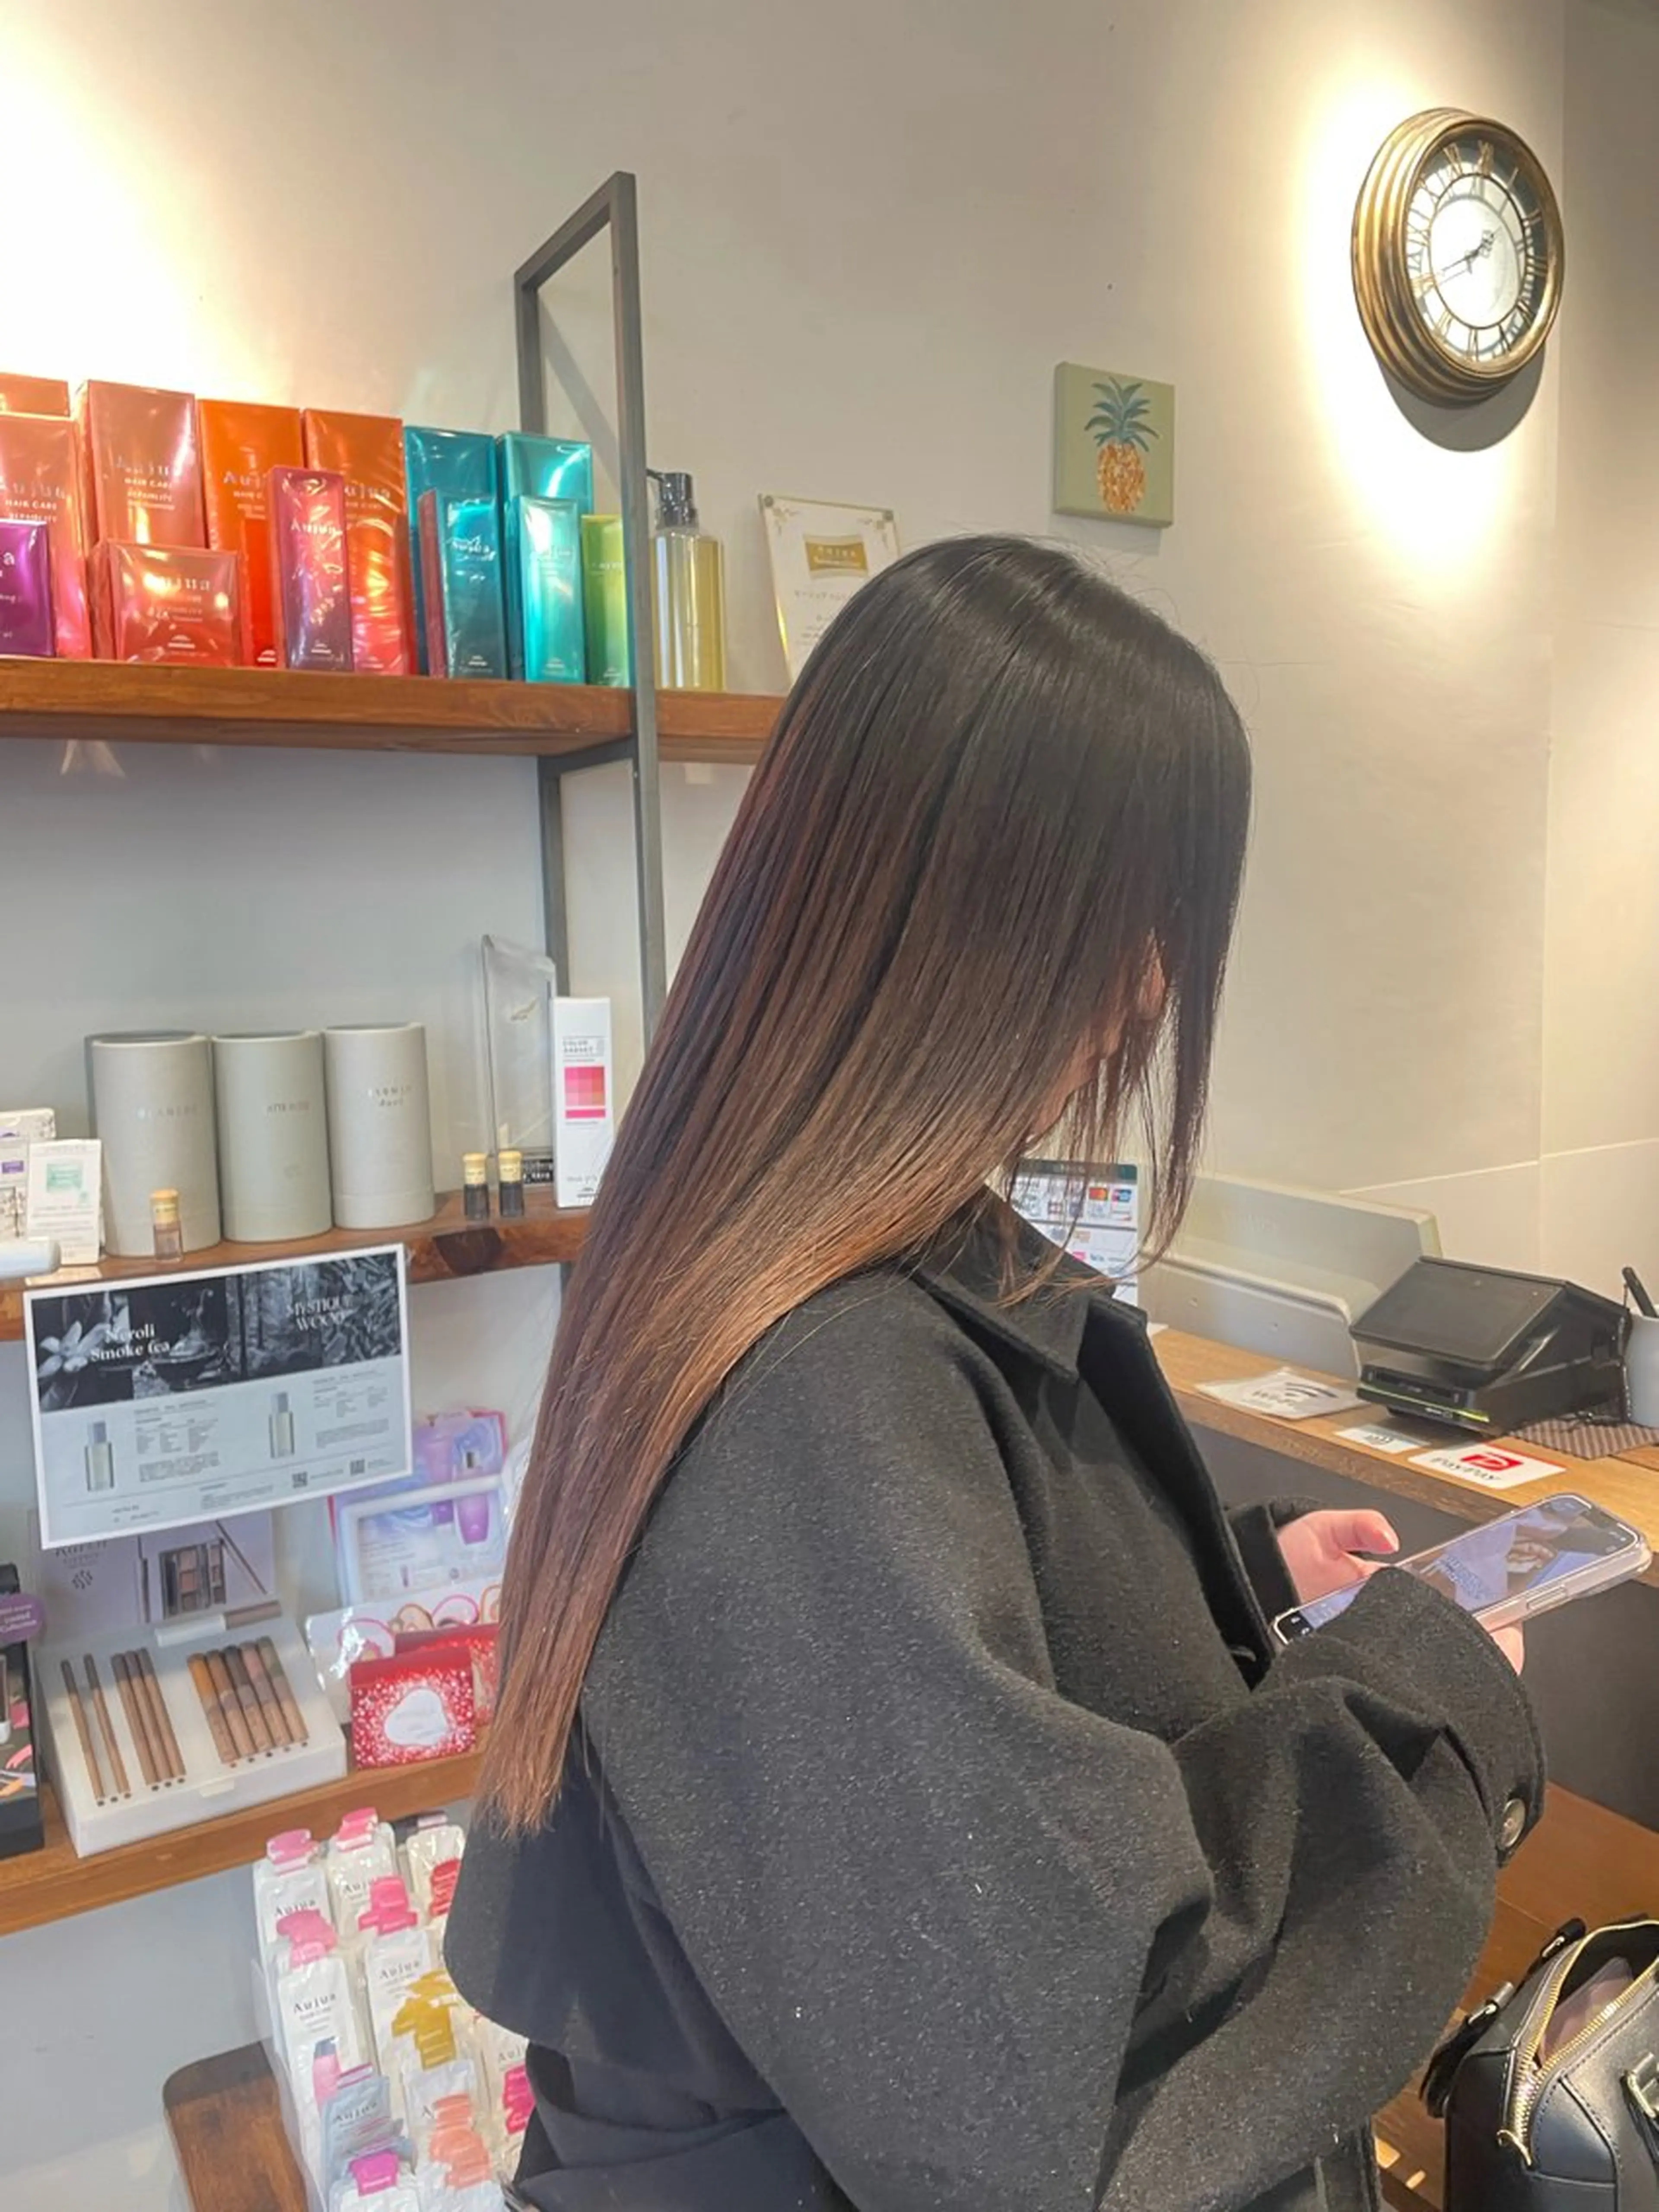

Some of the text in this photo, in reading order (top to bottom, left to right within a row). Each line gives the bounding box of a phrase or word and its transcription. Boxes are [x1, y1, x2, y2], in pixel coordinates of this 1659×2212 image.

[105, 1323, 155, 1344] Neroli
[90, 1344, 143, 1362] Smoke
[293, 1993, 337, 2015] Aujua
